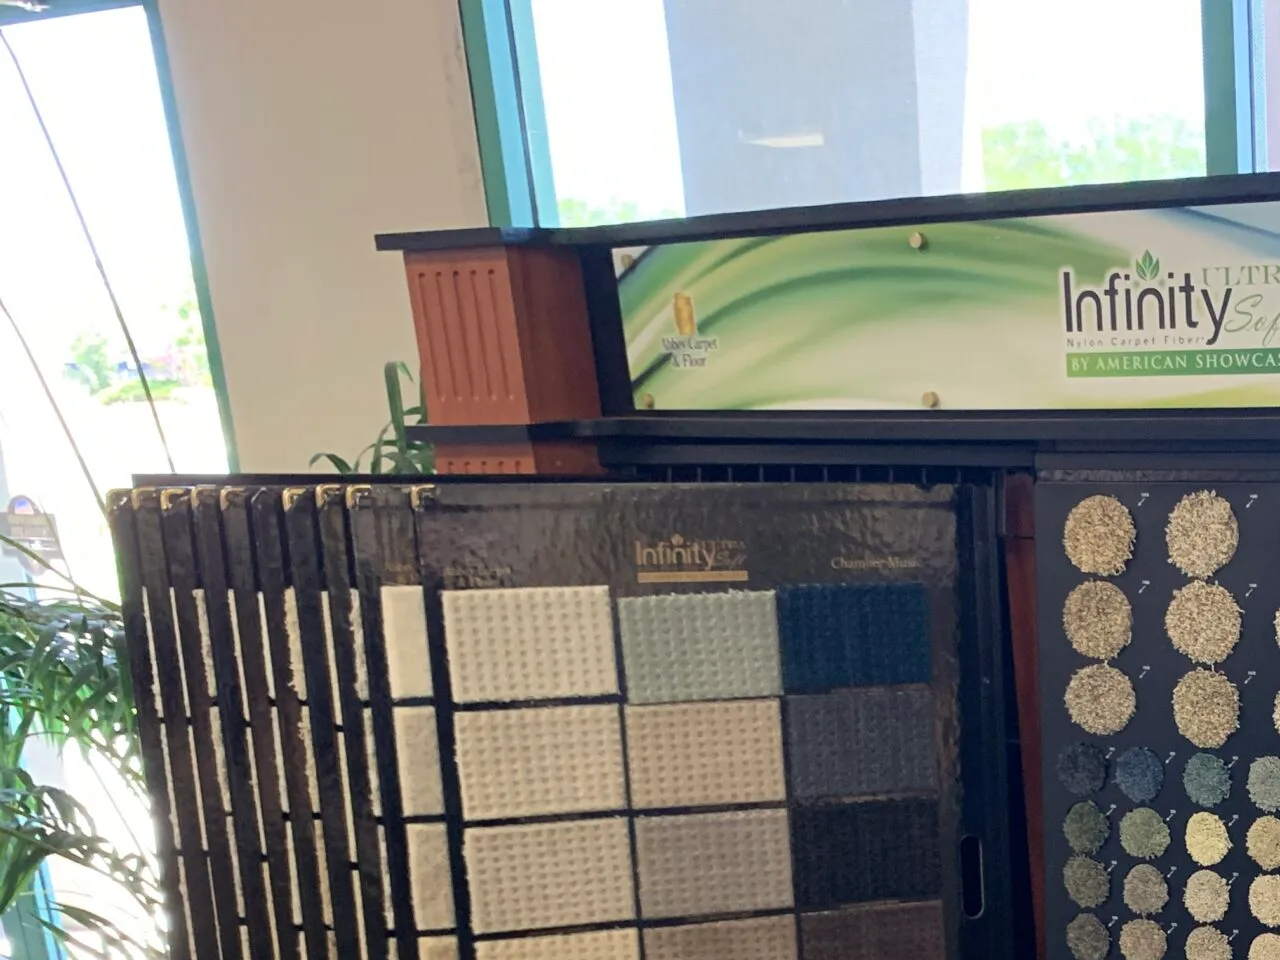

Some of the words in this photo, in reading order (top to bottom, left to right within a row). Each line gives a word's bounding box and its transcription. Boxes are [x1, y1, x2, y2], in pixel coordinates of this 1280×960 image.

[1063, 271, 1232, 346] Infinity
[1066, 337, 1103, 349] Nylon
[1111, 336, 1155, 347] Carpet
[1071, 356, 1090, 372] BY
[1096, 354, 1187, 371] AMERICAN
[635, 540, 716, 571] Infinity
